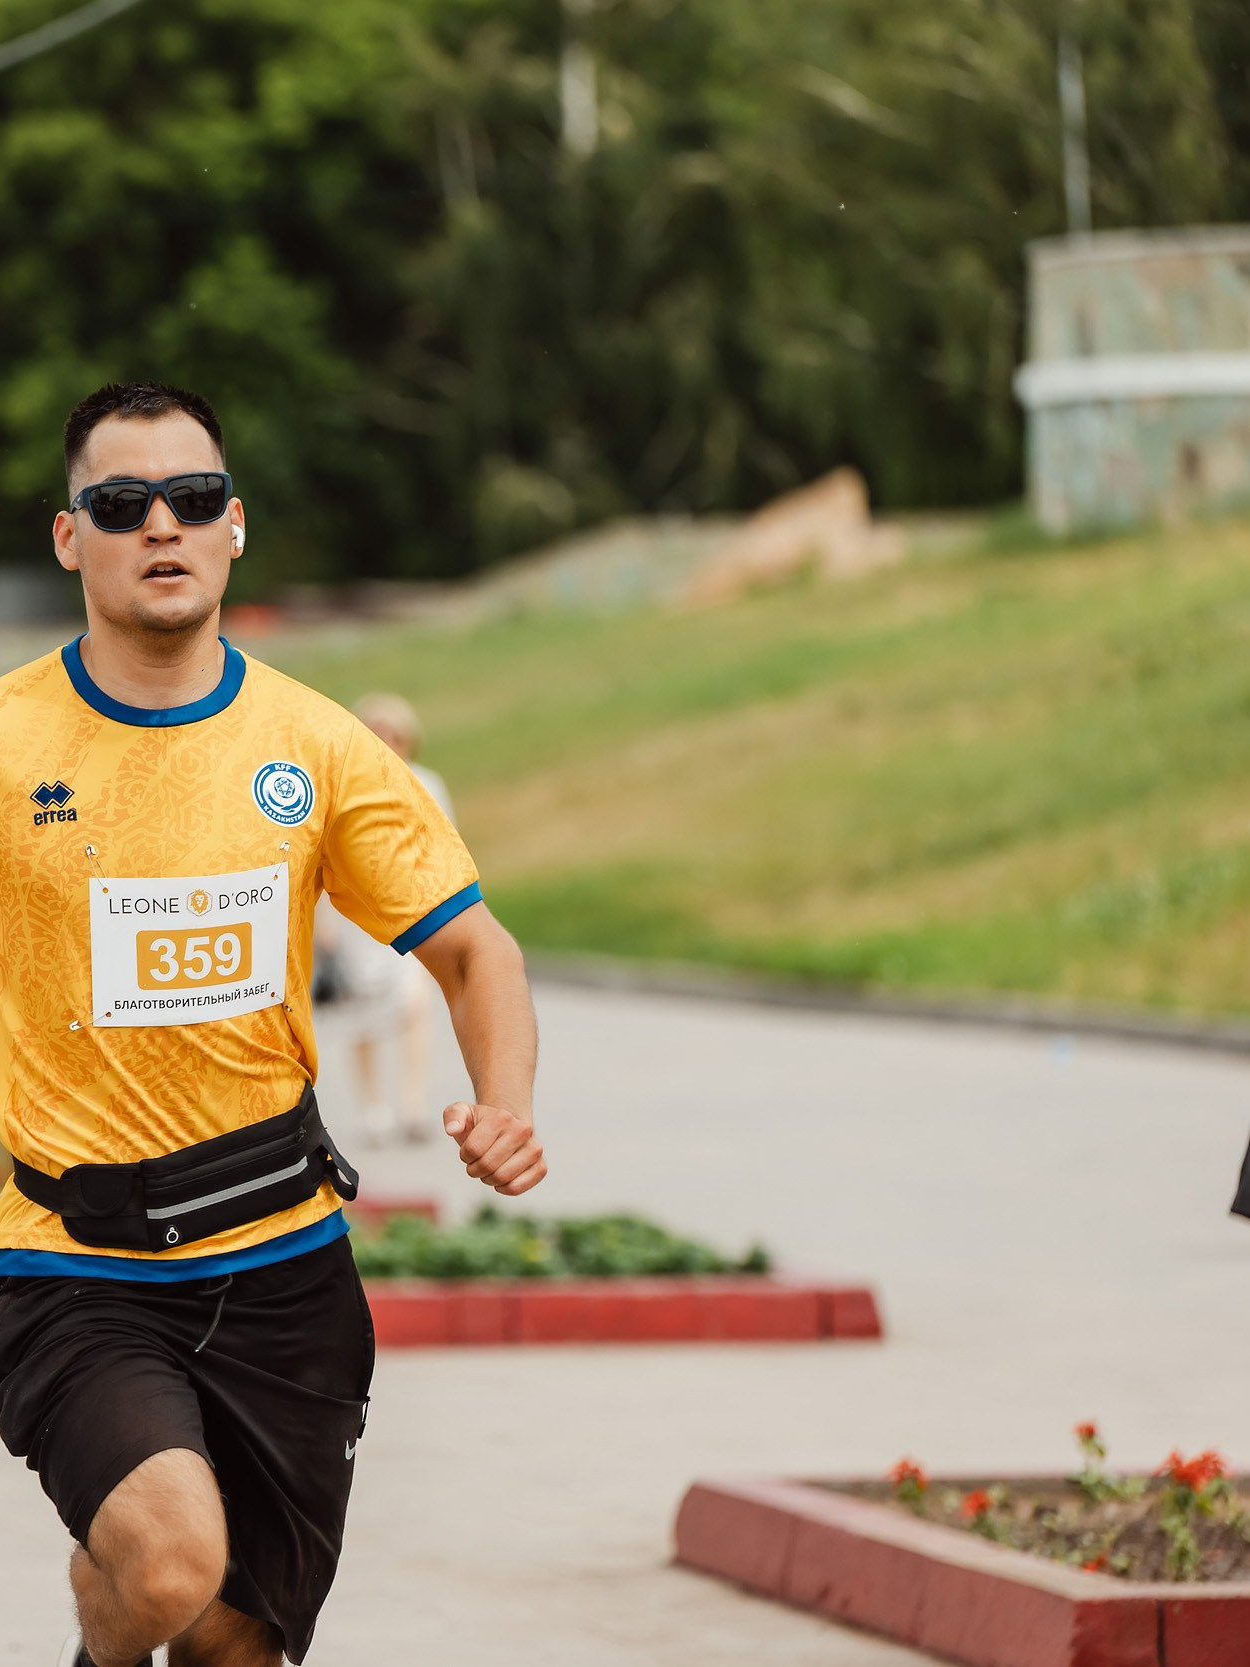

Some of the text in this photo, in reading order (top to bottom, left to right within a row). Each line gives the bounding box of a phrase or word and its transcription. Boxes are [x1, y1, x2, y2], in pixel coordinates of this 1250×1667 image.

[109, 886, 273, 914] LEONE D'ORO
[150, 932, 241, 982] 359
[114, 983, 269, 1010] БЛАГОТВОРИТЕЛЬНЫЙ ЗАБЕГ
